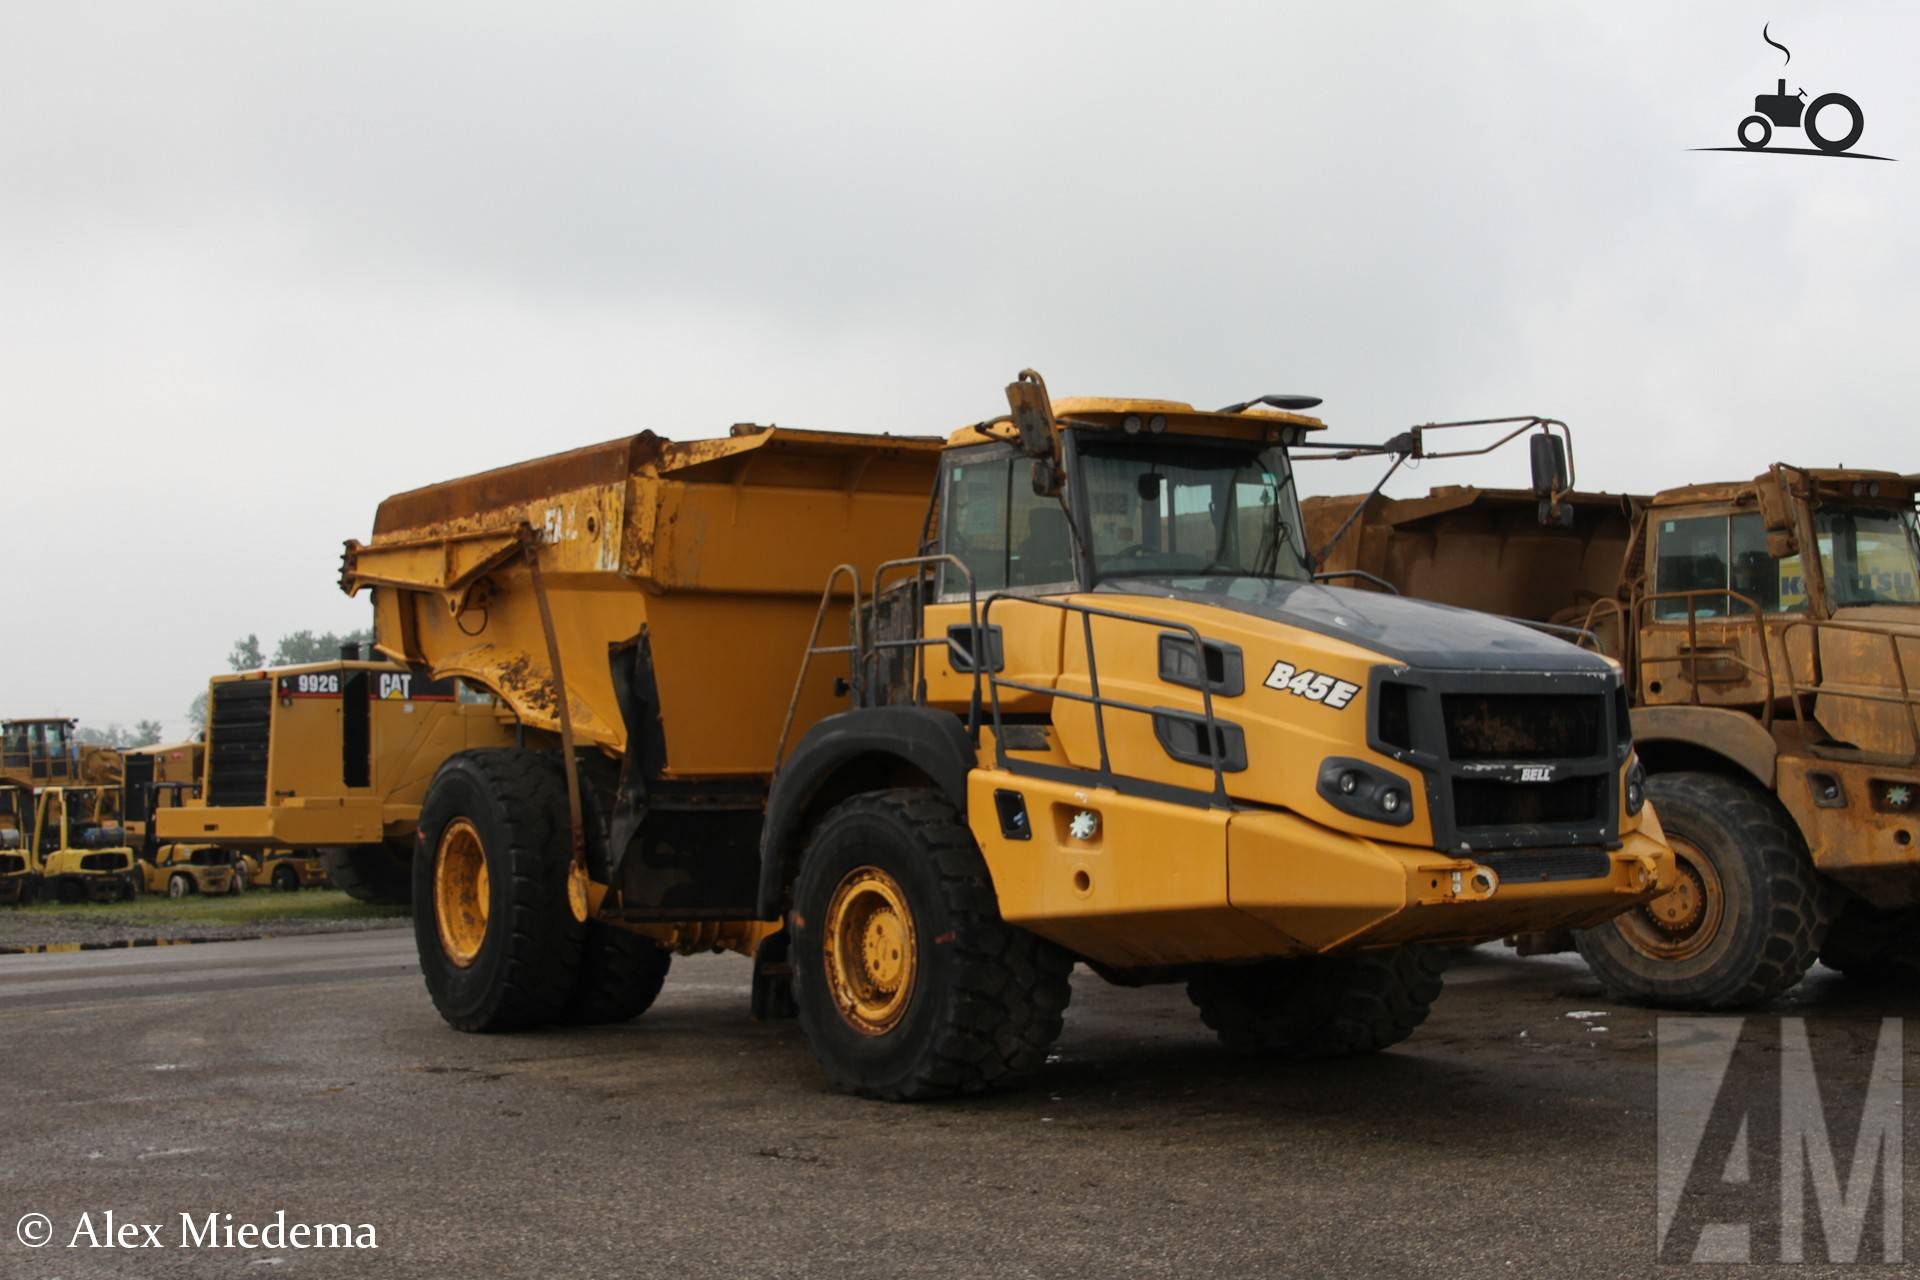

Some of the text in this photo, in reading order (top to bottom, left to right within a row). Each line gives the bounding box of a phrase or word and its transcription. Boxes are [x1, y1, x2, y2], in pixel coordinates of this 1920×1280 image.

[299, 674, 339, 693] 992G
[380, 673, 412, 699] CAT
[1263, 660, 1361, 710] B45E
[1521, 768, 1551, 781] BELL
